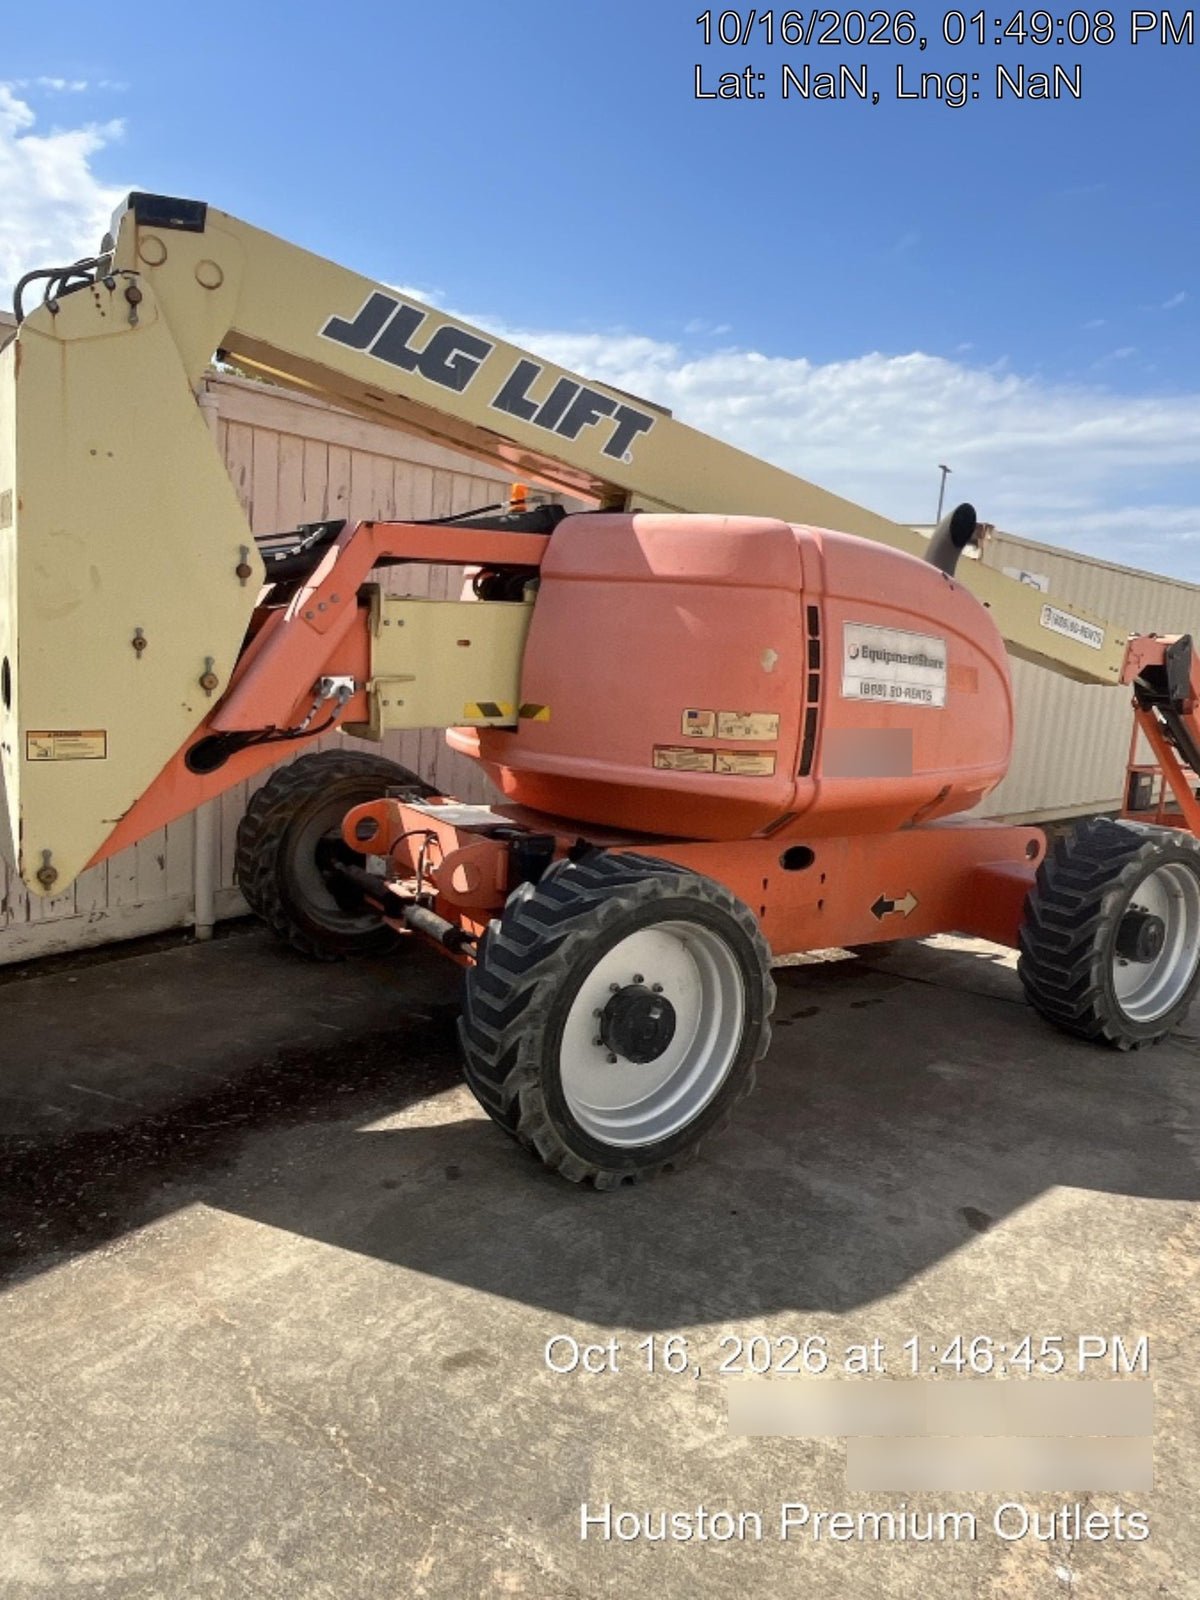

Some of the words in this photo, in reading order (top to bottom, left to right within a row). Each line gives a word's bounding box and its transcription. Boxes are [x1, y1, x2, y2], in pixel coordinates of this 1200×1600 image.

[318, 290, 496, 393] JLG
[489, 358, 656, 461] LIFT
[861, 645, 944, 669] EquipmentShare
